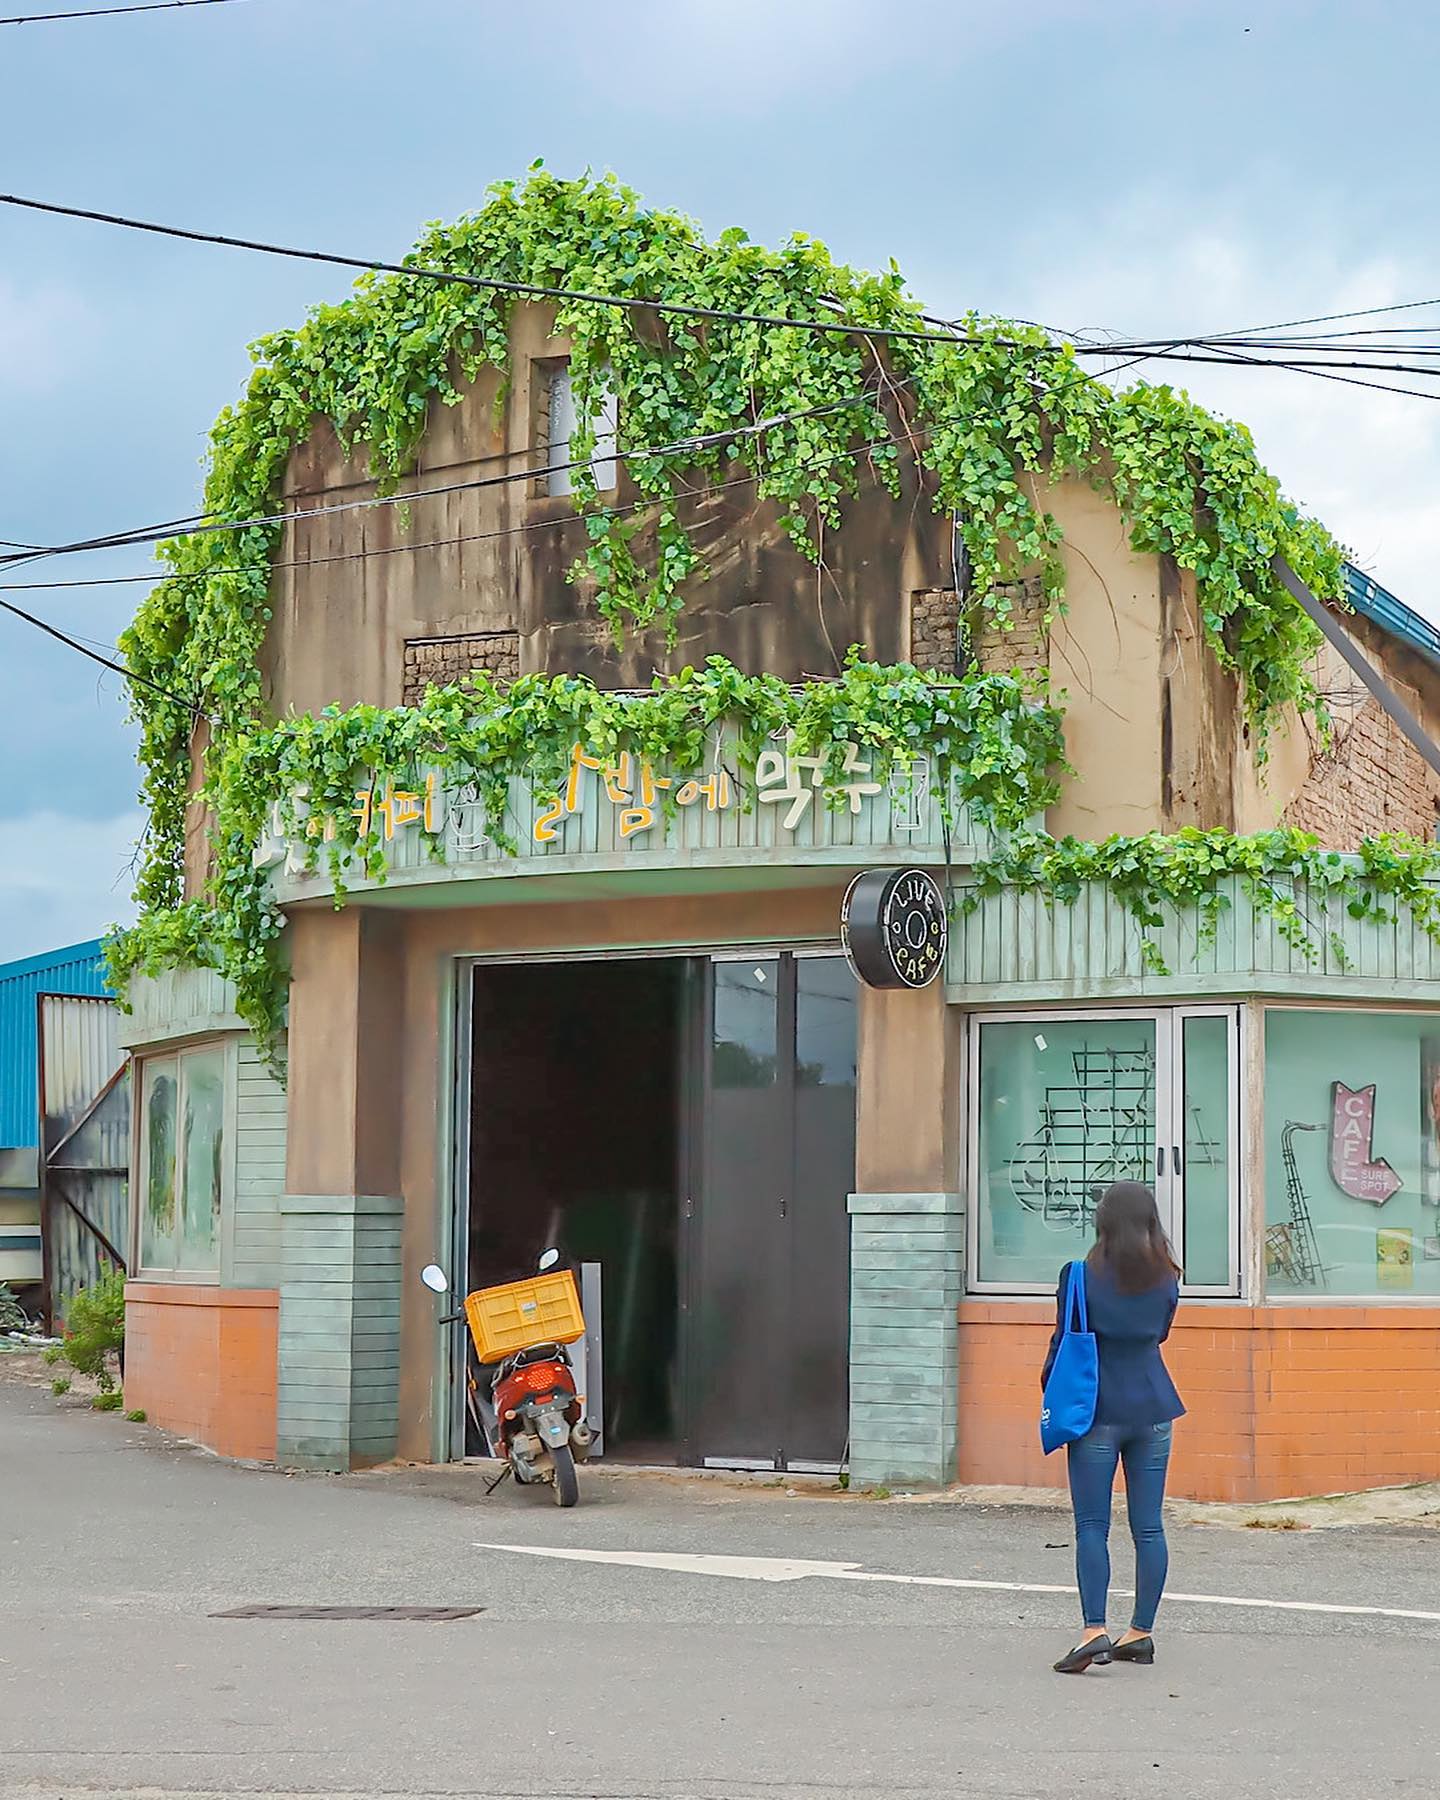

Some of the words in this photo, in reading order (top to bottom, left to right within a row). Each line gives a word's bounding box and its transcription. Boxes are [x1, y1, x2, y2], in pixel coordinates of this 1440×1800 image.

[350, 772, 438, 842] 커피
[755, 728, 883, 830] 맥주
[893, 879, 936, 912] LIVE
[896, 942, 939, 980] CAFE
[1341, 1097, 1364, 1181] CAFE
[1360, 1169, 1389, 1181] SURF
[1360, 1180, 1389, 1192] SPOT
